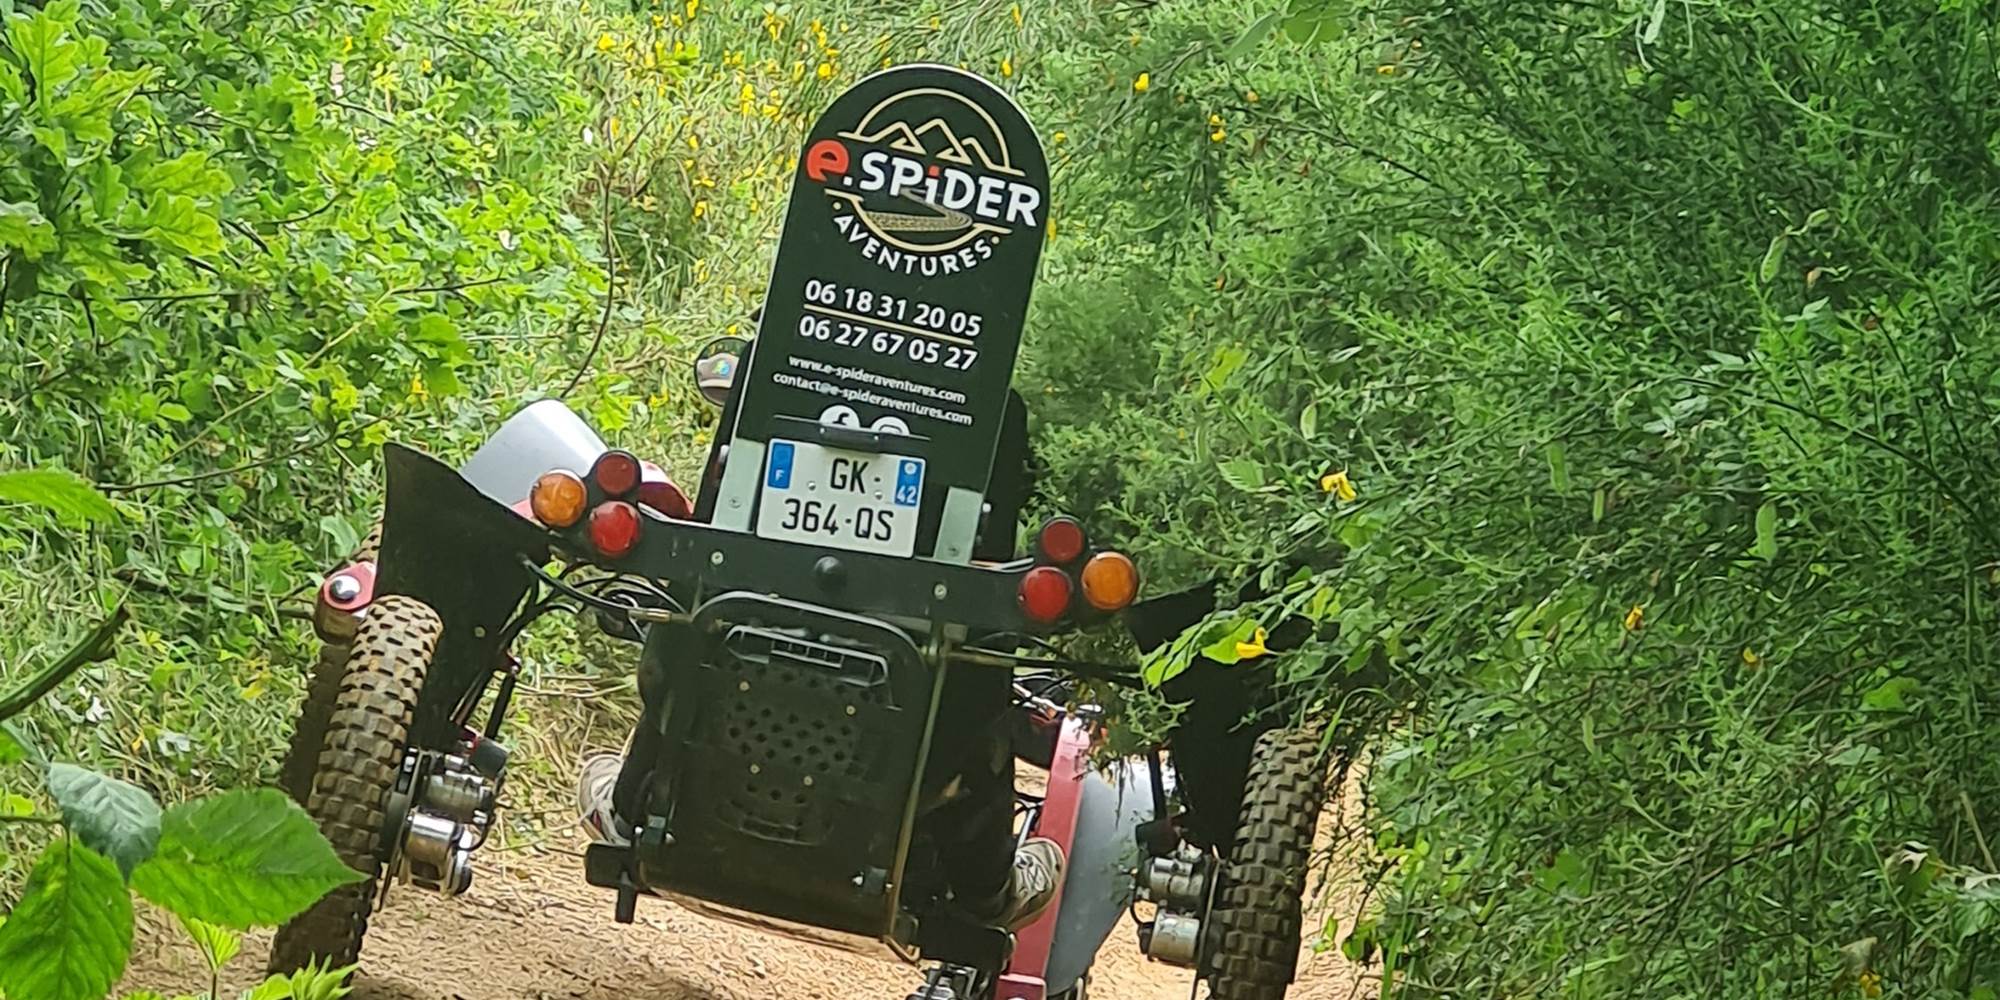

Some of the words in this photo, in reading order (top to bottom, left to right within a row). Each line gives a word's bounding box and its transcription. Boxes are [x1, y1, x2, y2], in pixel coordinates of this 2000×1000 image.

[834, 214, 993, 276] AVENTURES
[806, 280, 837, 304] 06
[844, 289, 873, 313] 18
[877, 295, 908, 320] 31
[913, 303, 945, 328] 20
[950, 312, 982, 336] 05
[799, 315, 832, 340] 06
[835, 323, 869, 347] 27
[872, 331, 904, 354] 67
[908, 339, 940, 363] 05
[945, 347, 979, 370] 27
[773, 374, 972, 425] contact@e-spideraventures.com
[789, 357, 966, 403] www.e-spideraventures.com
[774, 469, 784, 481] F
[896, 486, 917, 504] 42
